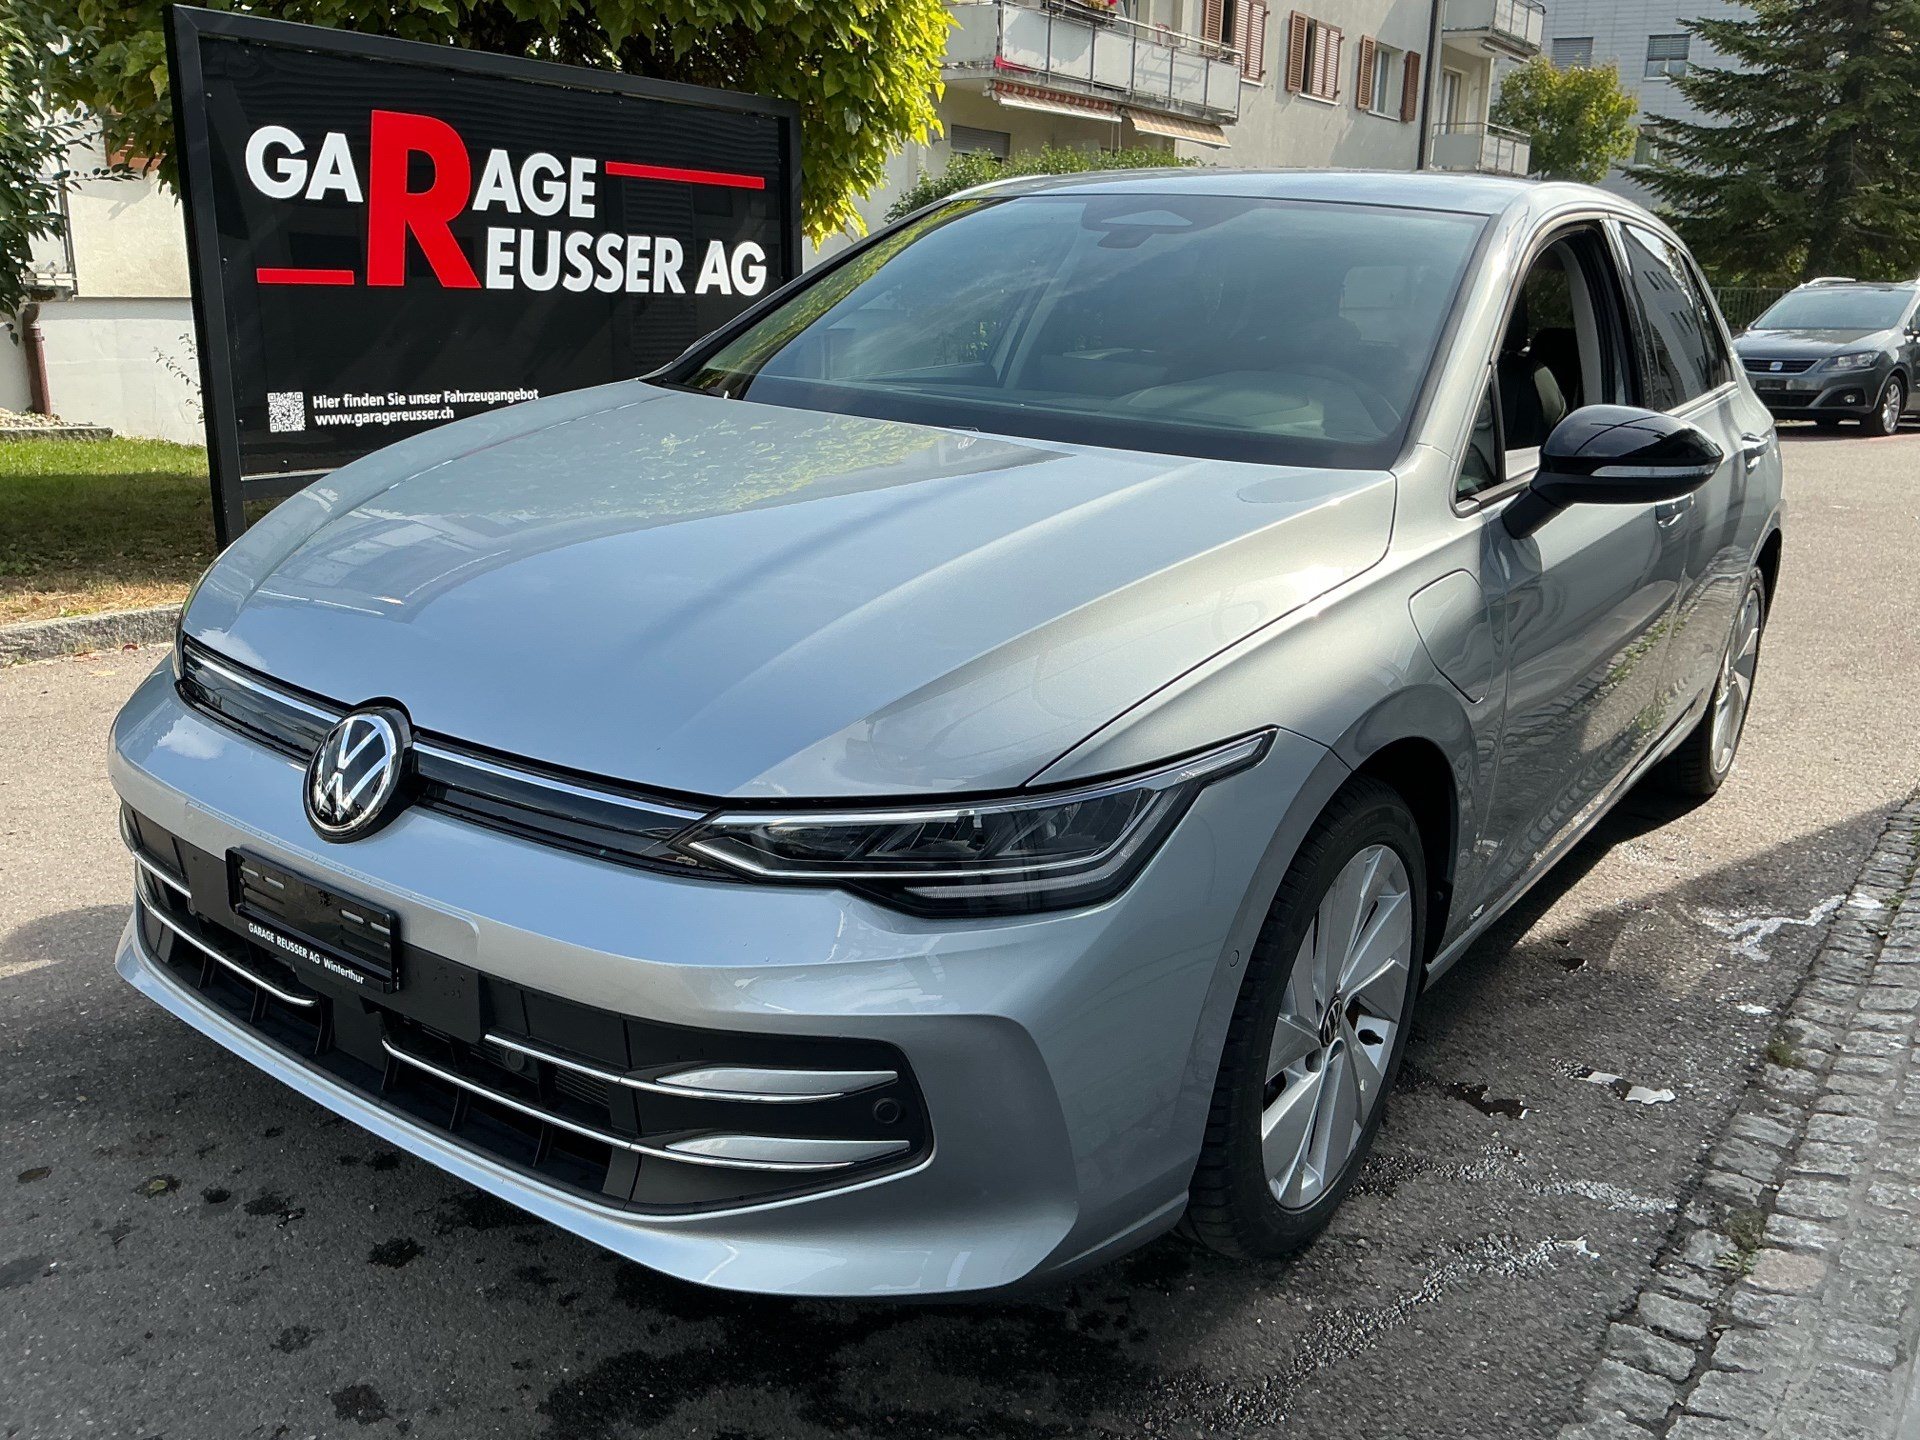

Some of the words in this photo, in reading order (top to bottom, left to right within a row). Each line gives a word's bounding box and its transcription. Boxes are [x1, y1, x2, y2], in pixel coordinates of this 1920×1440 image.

[246, 109, 597, 289] GARAGE
[694, 240, 767, 297] AG
[312, 394, 341, 410] Hier
[342, 392, 385, 409] finden
[387, 391, 407, 407] Sie
[408, 393, 442, 406] unser
[443, 387, 540, 406] Fahrzeugangebot
[314, 405, 455, 428] www.garagereusser.ch
[247, 921, 276, 944] GARAGE
[275, 934, 309, 960] REUSSER
[308, 950, 321, 966] AG
[322, 956, 365, 985] Winterthur
